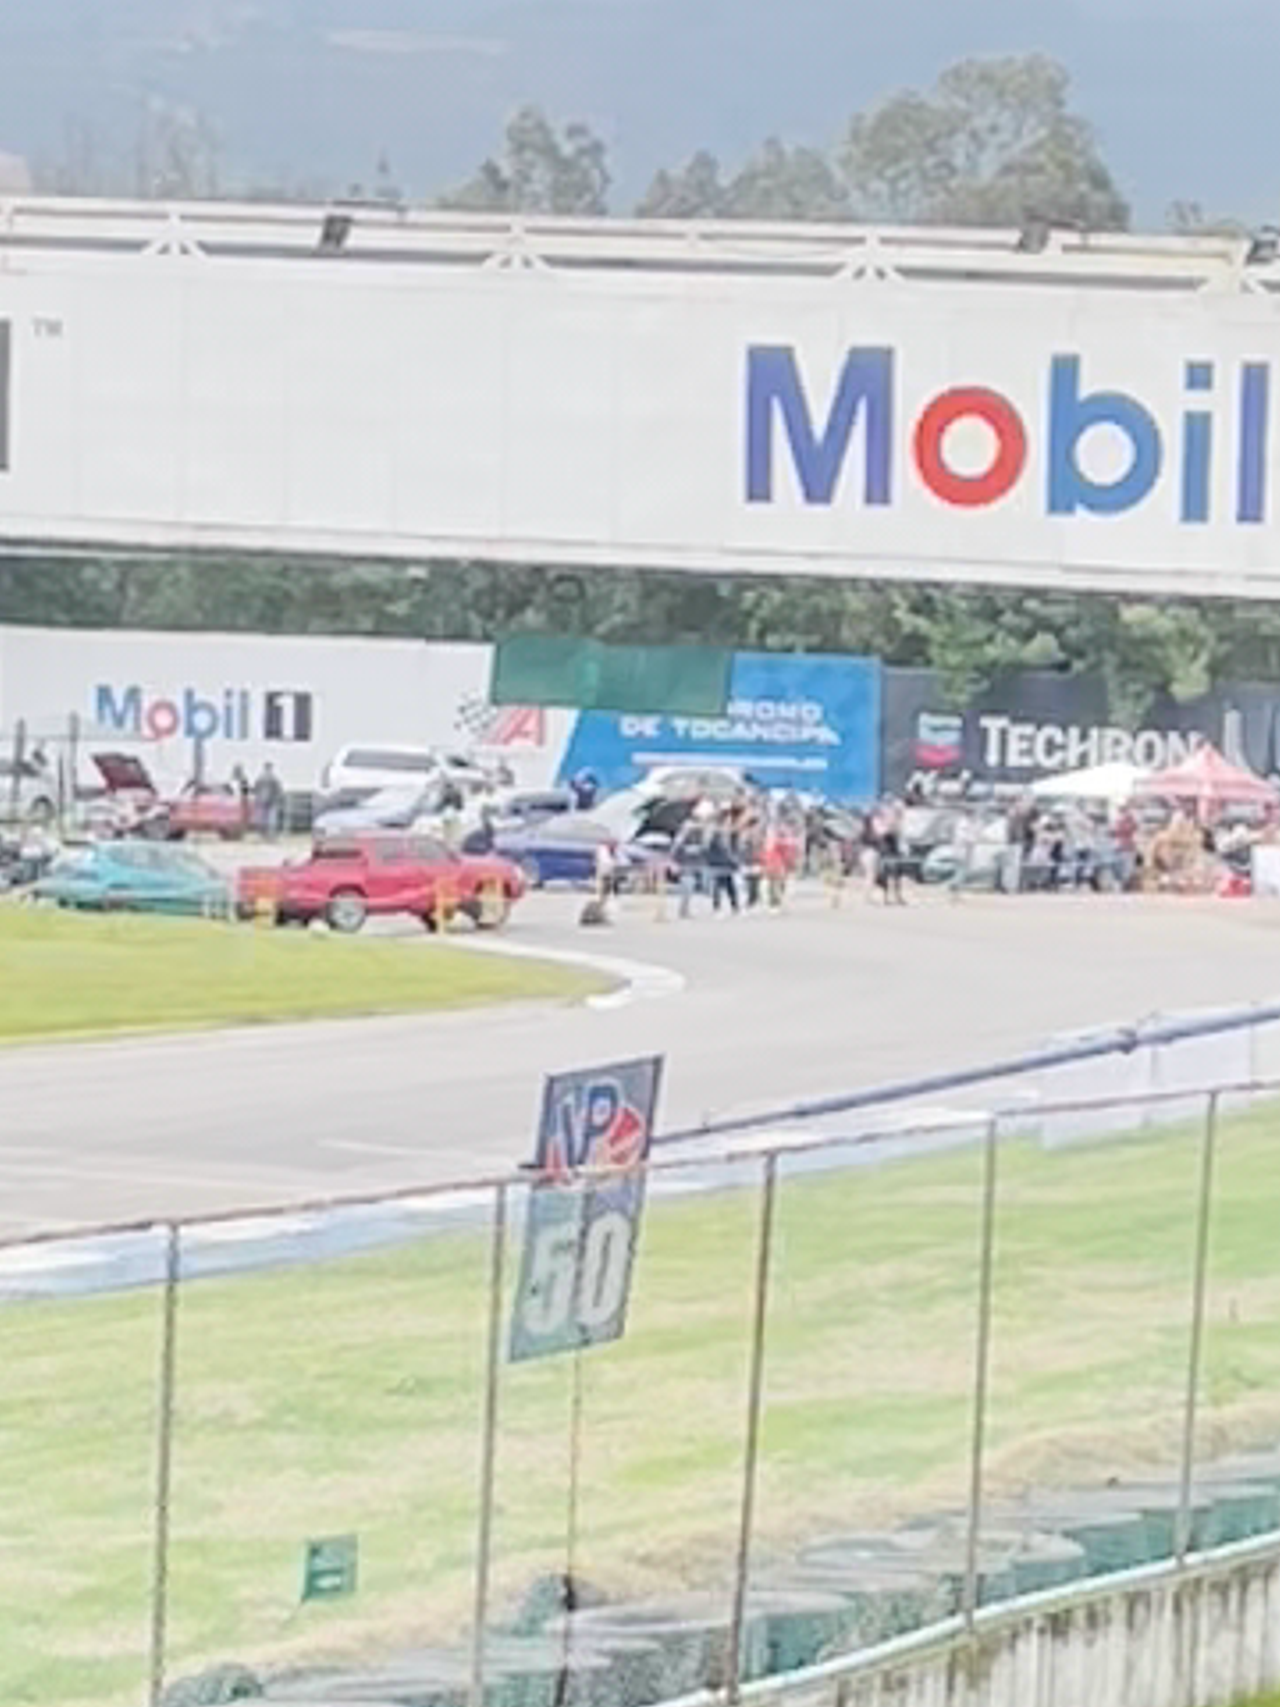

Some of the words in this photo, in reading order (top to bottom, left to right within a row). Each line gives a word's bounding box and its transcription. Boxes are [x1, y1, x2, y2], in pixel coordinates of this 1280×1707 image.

[745, 344, 1271, 524] Mobil
[95, 684, 250, 740] Mobil
[979, 713, 1206, 769] TECHRON
[523, 1210, 632, 1335] 50
